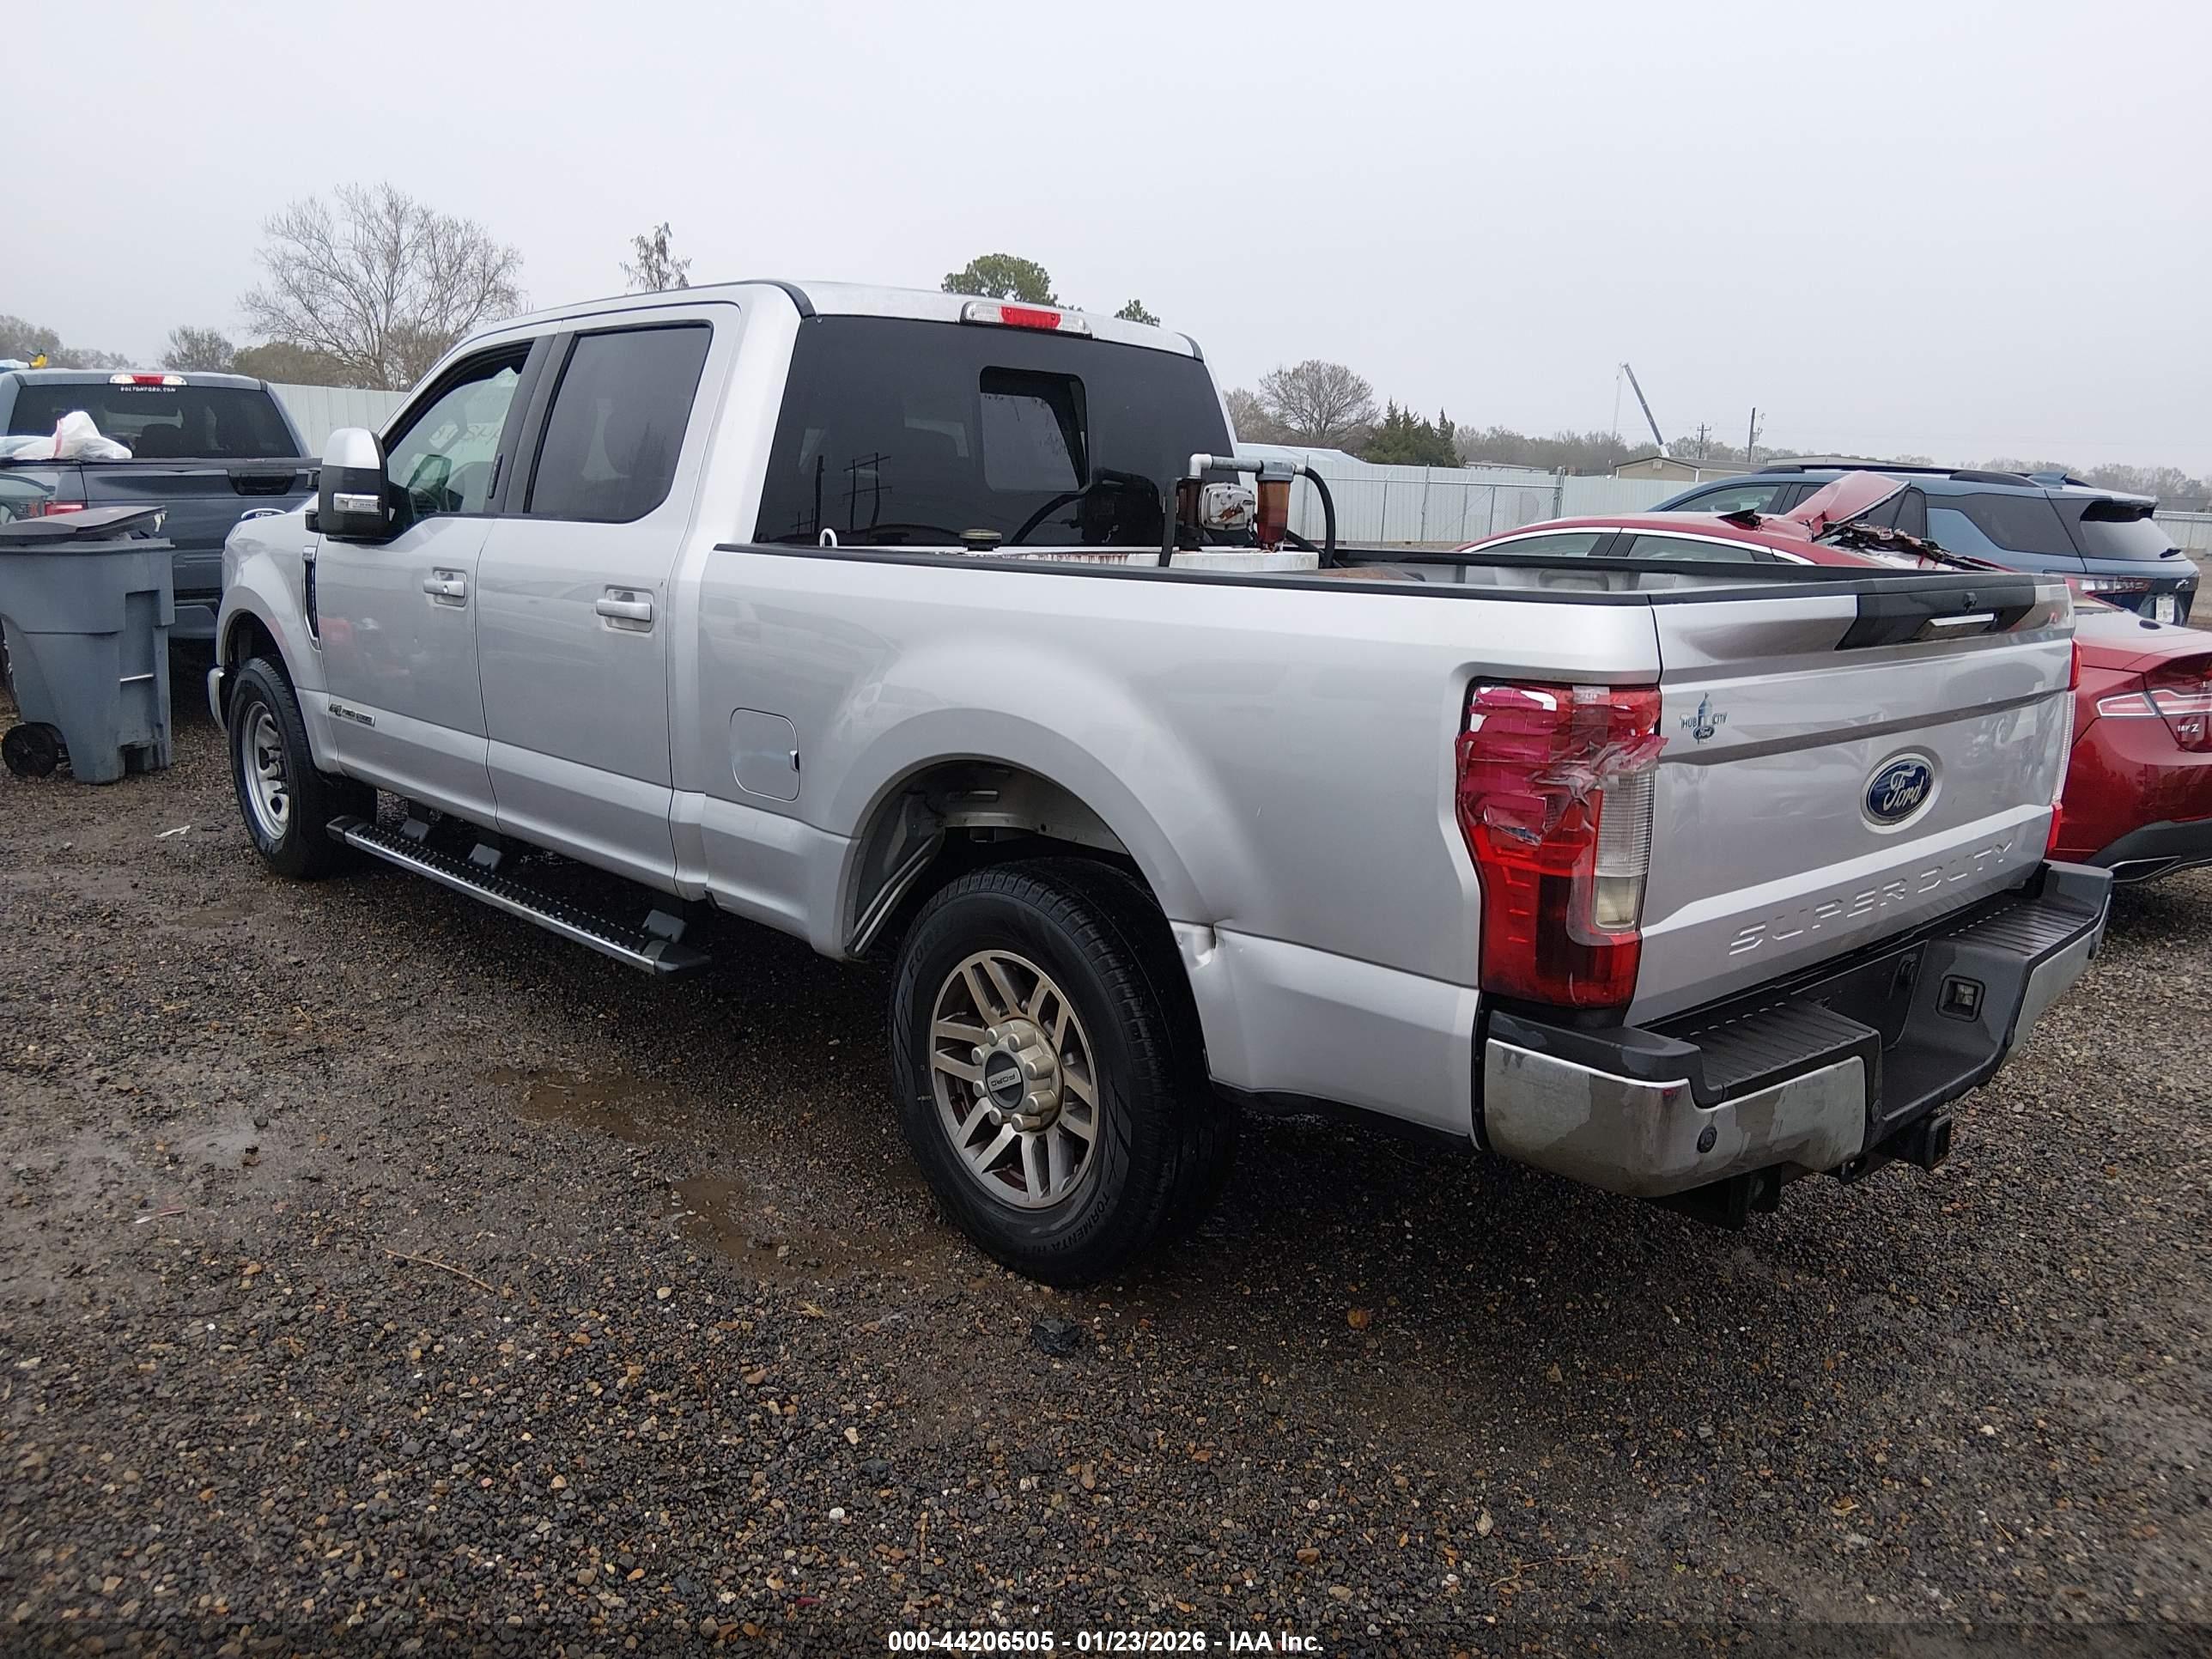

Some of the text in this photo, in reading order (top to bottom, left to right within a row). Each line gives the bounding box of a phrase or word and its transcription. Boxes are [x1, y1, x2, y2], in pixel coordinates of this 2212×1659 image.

[1680, 713, 1728, 730] HUB CITY
[1882, 769, 1924, 811] Ford
[1729, 839, 2012, 956] SUPER DUTY
[990, 1073, 1016, 1087] FORD
[1051, 1191, 1111, 1251] TORMENTA
